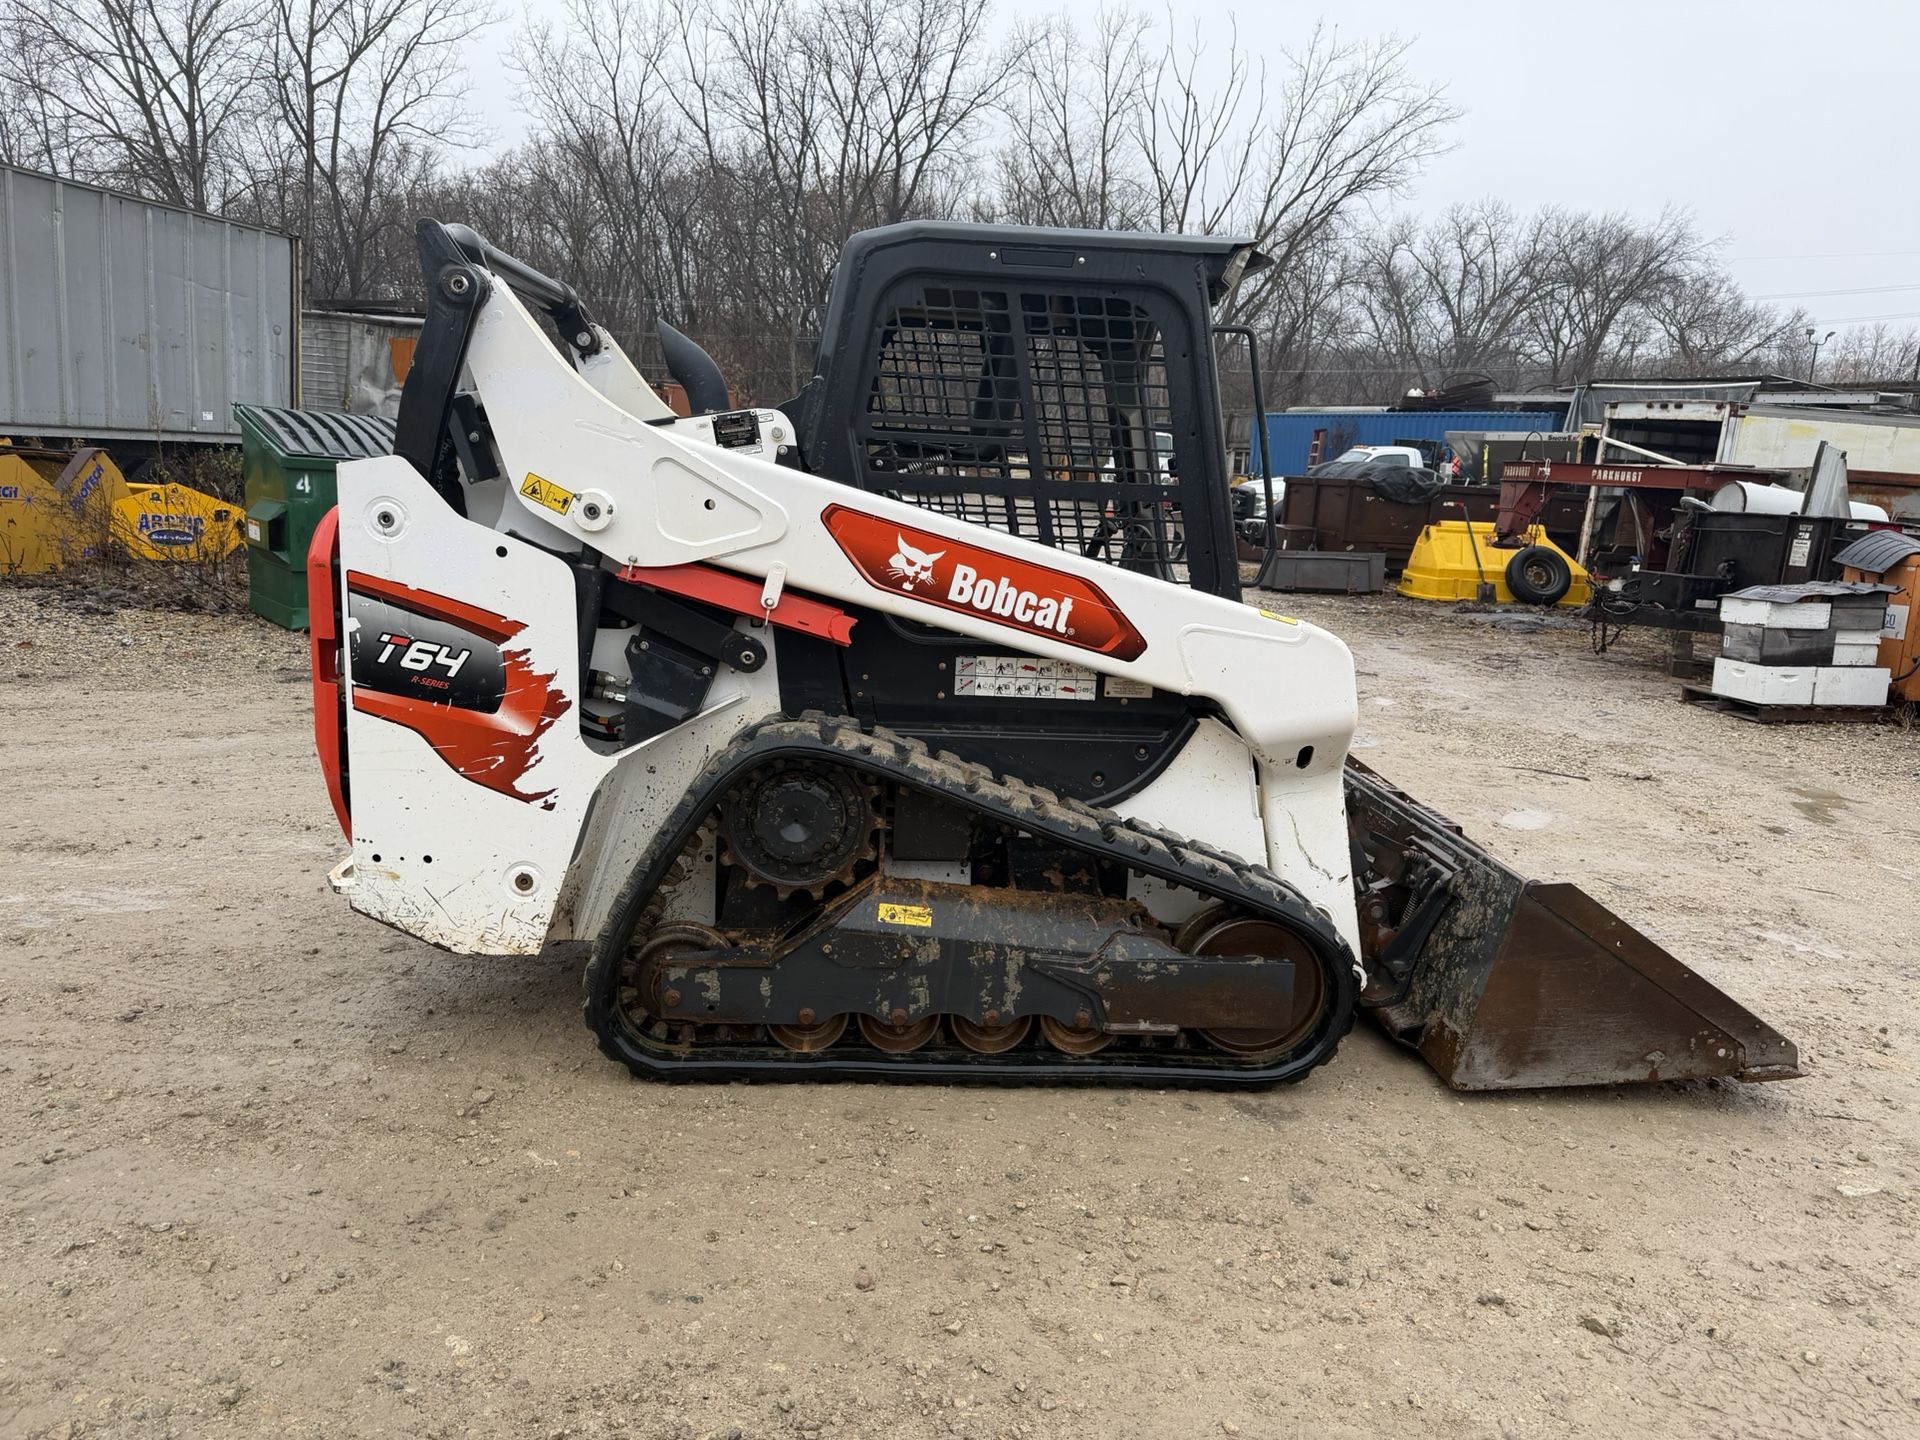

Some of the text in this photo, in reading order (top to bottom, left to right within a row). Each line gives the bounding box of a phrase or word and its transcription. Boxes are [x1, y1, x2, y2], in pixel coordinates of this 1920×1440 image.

[295, 473, 311, 494] 4
[1591, 469, 1643, 483] PARKHURST
[947, 563, 1074, 635] Bobcat
[377, 633, 471, 678] T64
[410, 675, 450, 690] R-SERIES
